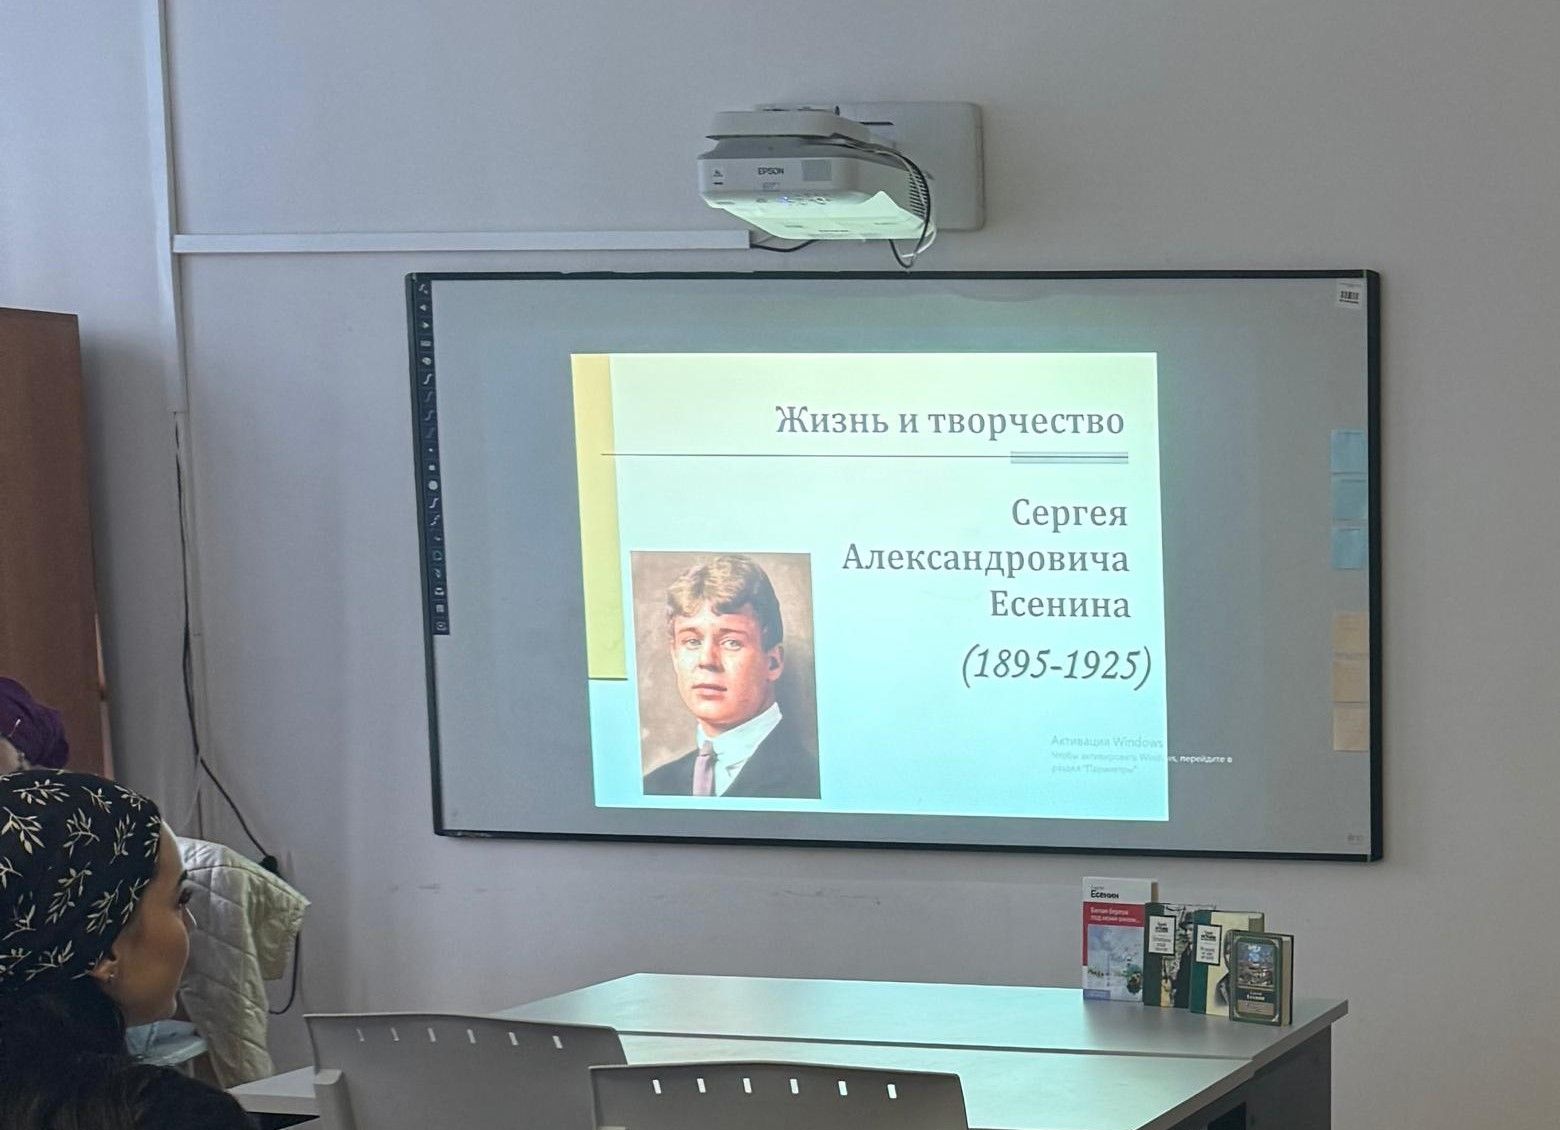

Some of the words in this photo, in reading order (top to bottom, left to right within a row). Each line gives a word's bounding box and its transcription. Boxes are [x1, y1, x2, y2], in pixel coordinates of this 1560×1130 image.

[757, 166, 785, 176] EPSON
[775, 405, 889, 433] Жизнь
[899, 413, 919, 433] и
[927, 413, 1125, 442] творчество
[1011, 498, 1128, 533] Сергея
[842, 543, 1130, 579] Александровича
[990, 590, 1132, 618] Есенина
[962, 643, 1153, 692] (1895-1925)
[1051, 735, 1111, 749] Активация
[1113, 736, 1164, 749] Windows
